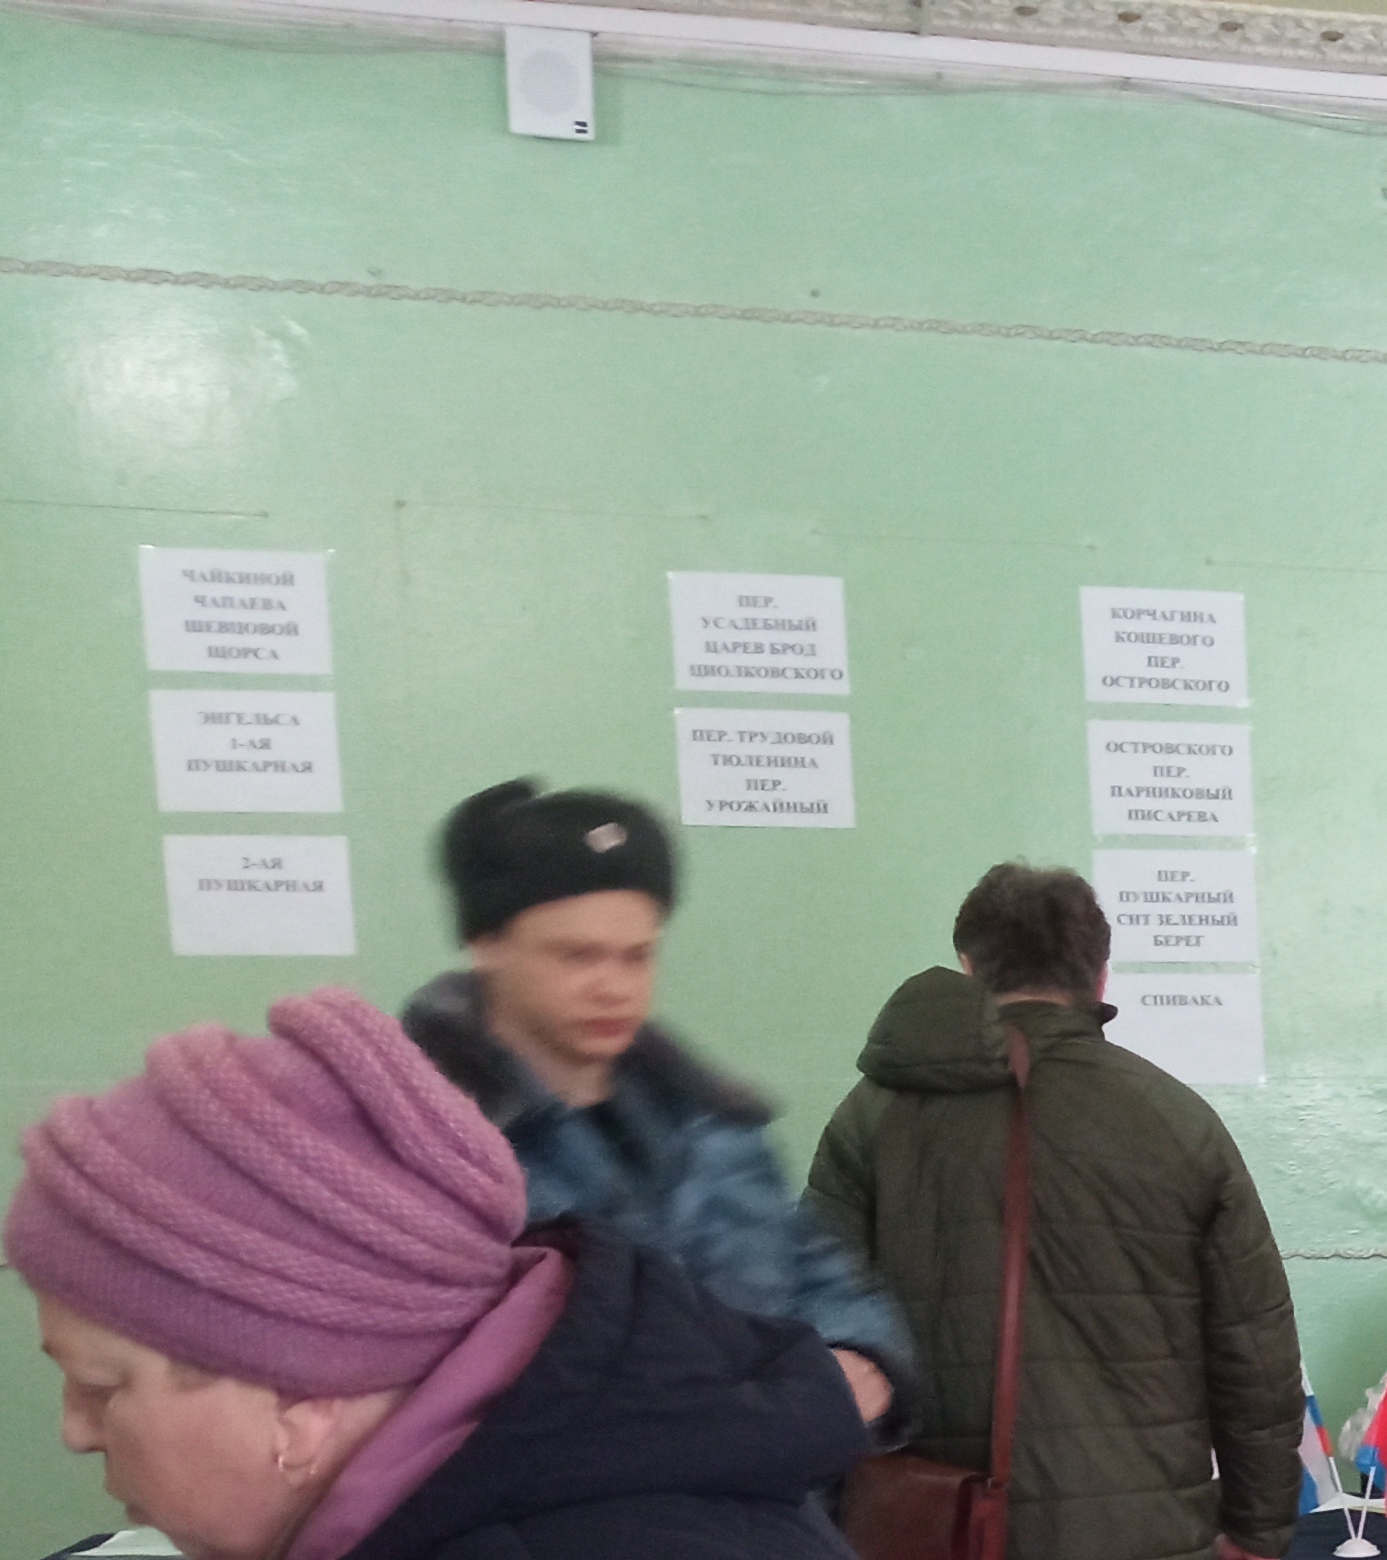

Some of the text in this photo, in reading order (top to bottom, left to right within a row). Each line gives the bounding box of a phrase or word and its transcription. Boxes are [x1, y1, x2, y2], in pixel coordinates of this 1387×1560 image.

[181, 567, 295, 587] ЧАЙКИНОЙ
[194, 595, 287, 612] ЧАПАЕВА
[737, 594, 778, 608] ПЕР.
[1110, 606, 1217, 624] КОРЧАГИНА
[184, 619, 299, 637] ШЕВЦОВОЙ
[700, 615, 817, 633] УСАДЕБНЫЙ
[1114, 630, 1215, 648] КОШЕВОГО
[206, 645, 280, 661] ЩОРСА
[704, 640, 817, 657] ЦАРЕВ БРОД
[1146, 654, 1184, 669] ПЕР.
[690, 663, 844, 681] ЦИОЛКОВСКОГО
[1101, 674, 1231, 693] ОСТРОВСКОГО
[198, 711, 300, 726] ЭНГЕЛЬСА
[230, 737, 272, 750] 1-АЯ
[691, 728, 835, 746] ПЕР. ТРУДОВОЙ
[1105, 740, 1234, 758] ОСТРОВСКОГО
[186, 759, 314, 773] ПУШКАРНАЯ
[710, 753, 819, 769] ТЮЛЕНИНА
[1152, 765, 1190, 778] ПЕР.
[745, 778, 787, 792] ПЕР.
[1110, 784, 1233, 801] ПАРНИКОВЫЙ
[704, 798, 829, 815] УРОЖАЙНЫЙ
[1127, 808, 1219, 823] ПИСАРЕВА
[241, 856, 283, 870] 2-АЯ
[1156, 869, 1195, 883] ПЕР.
[198, 878, 325, 893] ПУШКАРНАЯ
[1118, 889, 1235, 904] ПУШКАРНЫЙ
[1157, 912, 1239, 927] ЗЕЛЕНЫЙ
[1152, 934, 1205, 948] БЕРЕГ
[1140, 994, 1224, 1008] СПИВАКА
